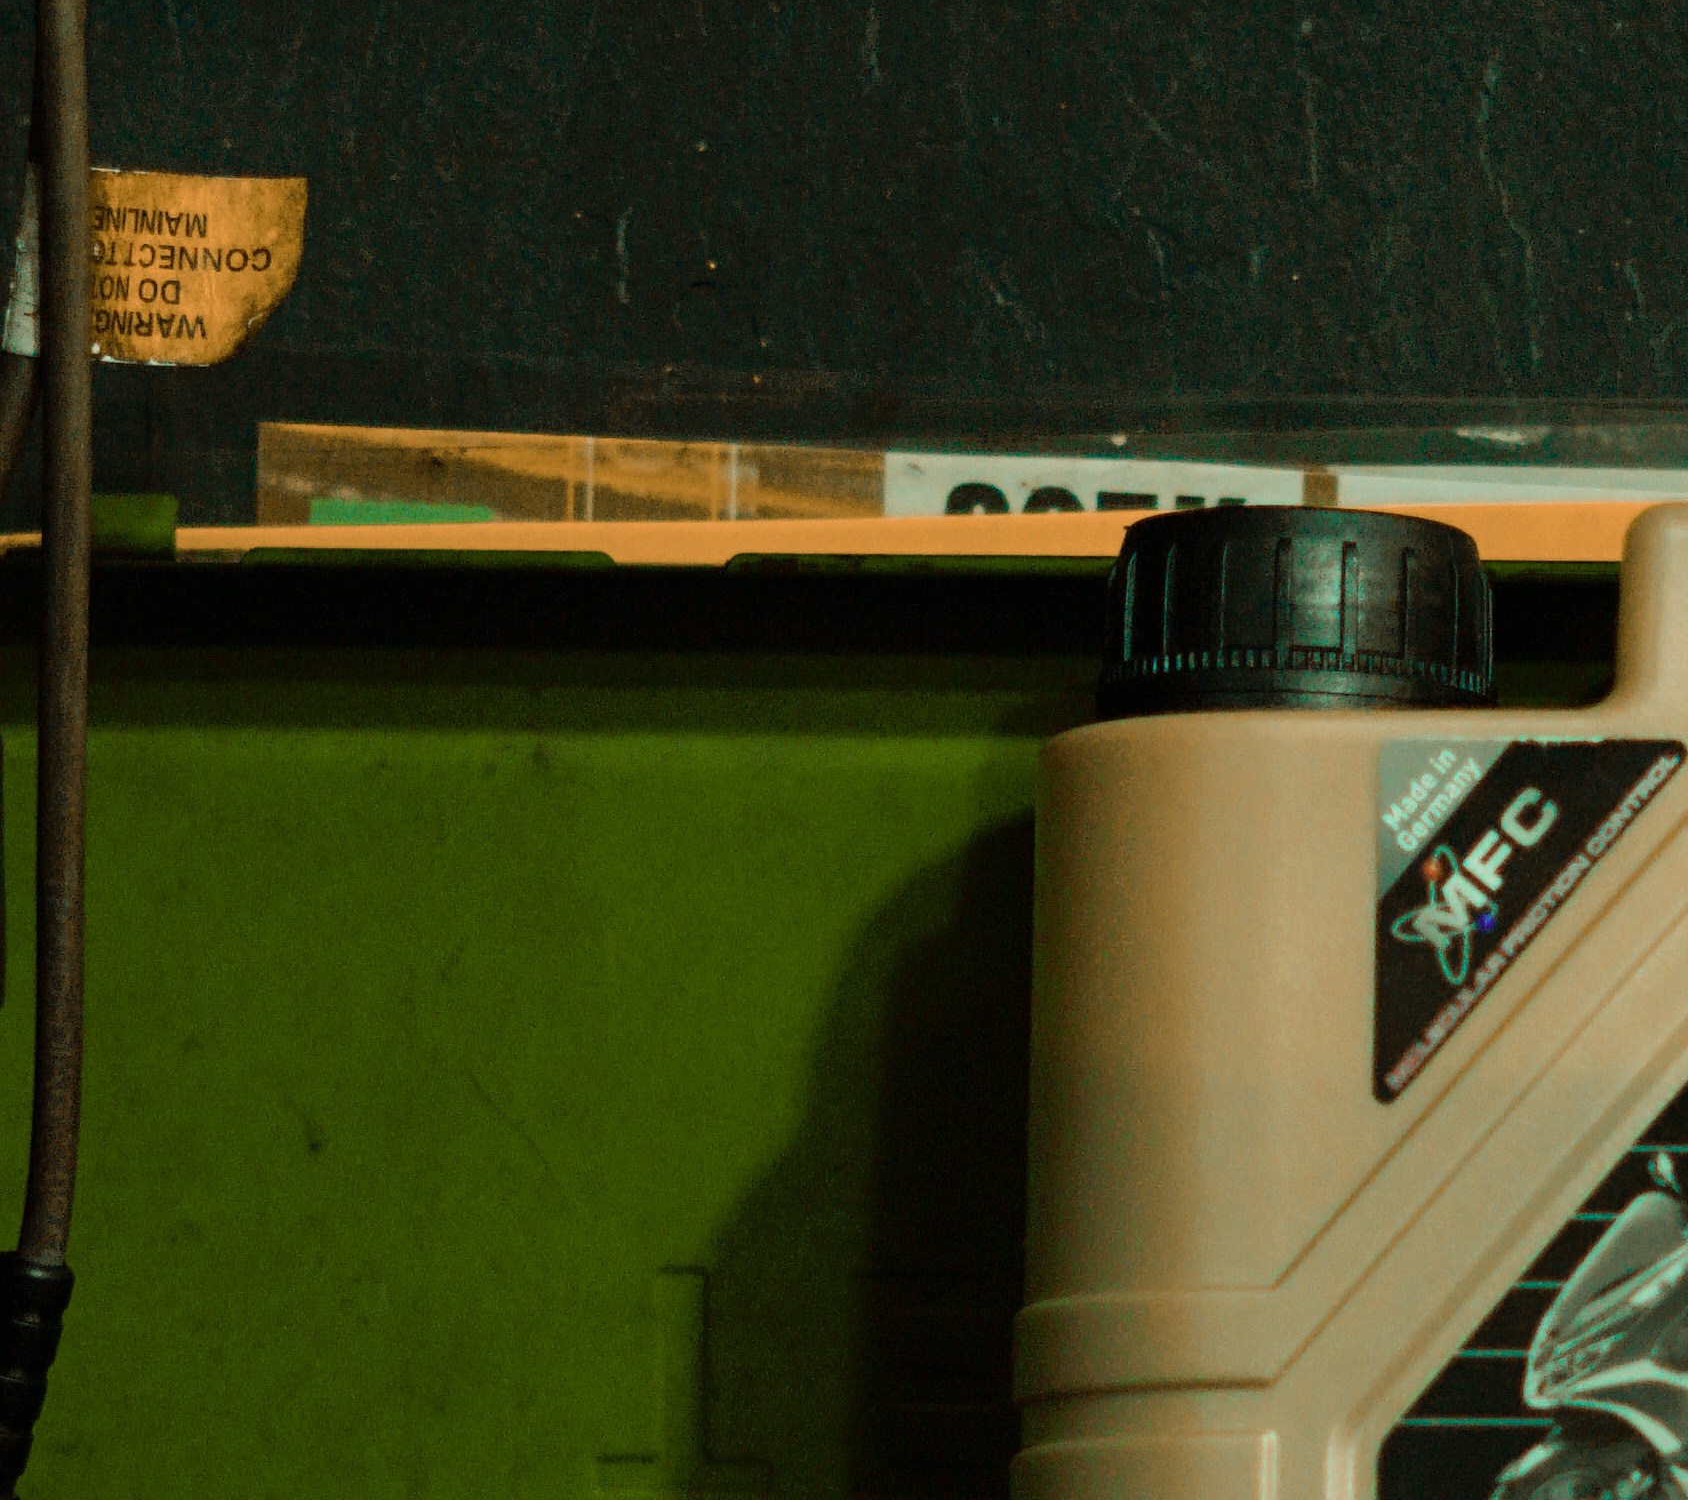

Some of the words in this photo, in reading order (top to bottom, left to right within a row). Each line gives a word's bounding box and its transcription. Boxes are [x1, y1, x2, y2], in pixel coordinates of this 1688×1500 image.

[93, 206, 207, 238] MAINLINE
[124, 243, 272, 273] CONNECT
[138, 278, 181, 305] DO
[1383, 773, 1437, 831] Made
[1430, 748, 1457, 775] in
[1397, 757, 1482, 852] Germany
[1584, 753, 1682, 858] CONTROL
[1414, 786, 1560, 947] MFC
